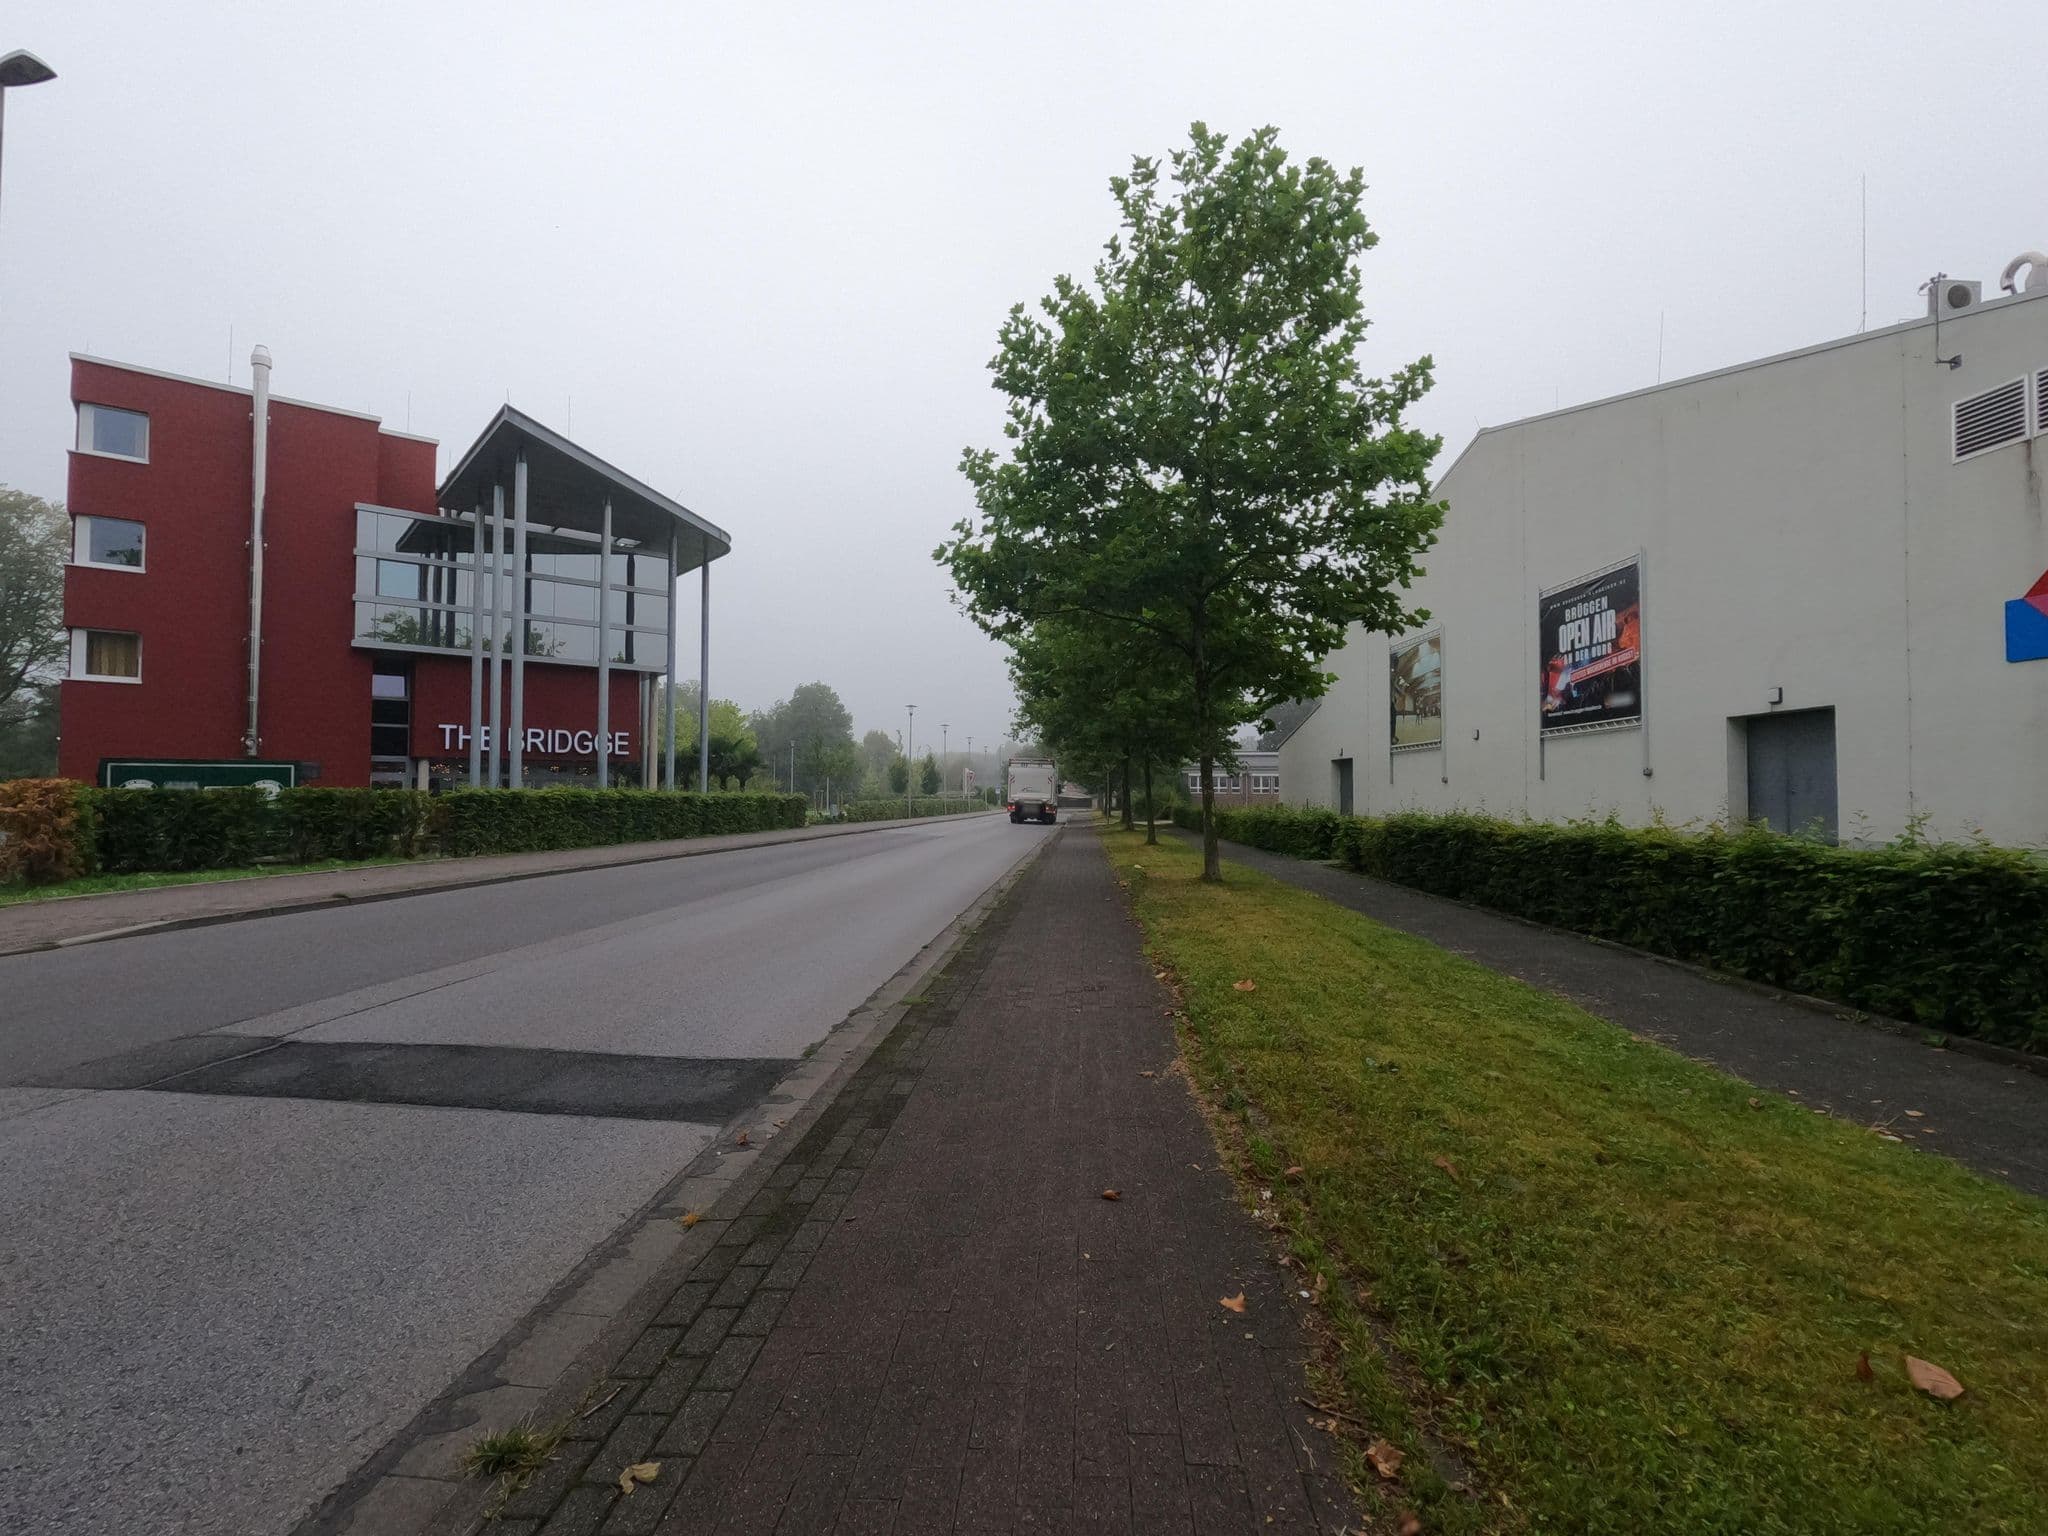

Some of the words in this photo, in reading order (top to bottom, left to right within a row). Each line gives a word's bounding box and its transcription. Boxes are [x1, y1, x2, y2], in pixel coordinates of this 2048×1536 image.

[1559, 617, 1590, 653] OPEN
[1592, 609, 1616, 644] AIR
[438, 724, 491, 751] THE
